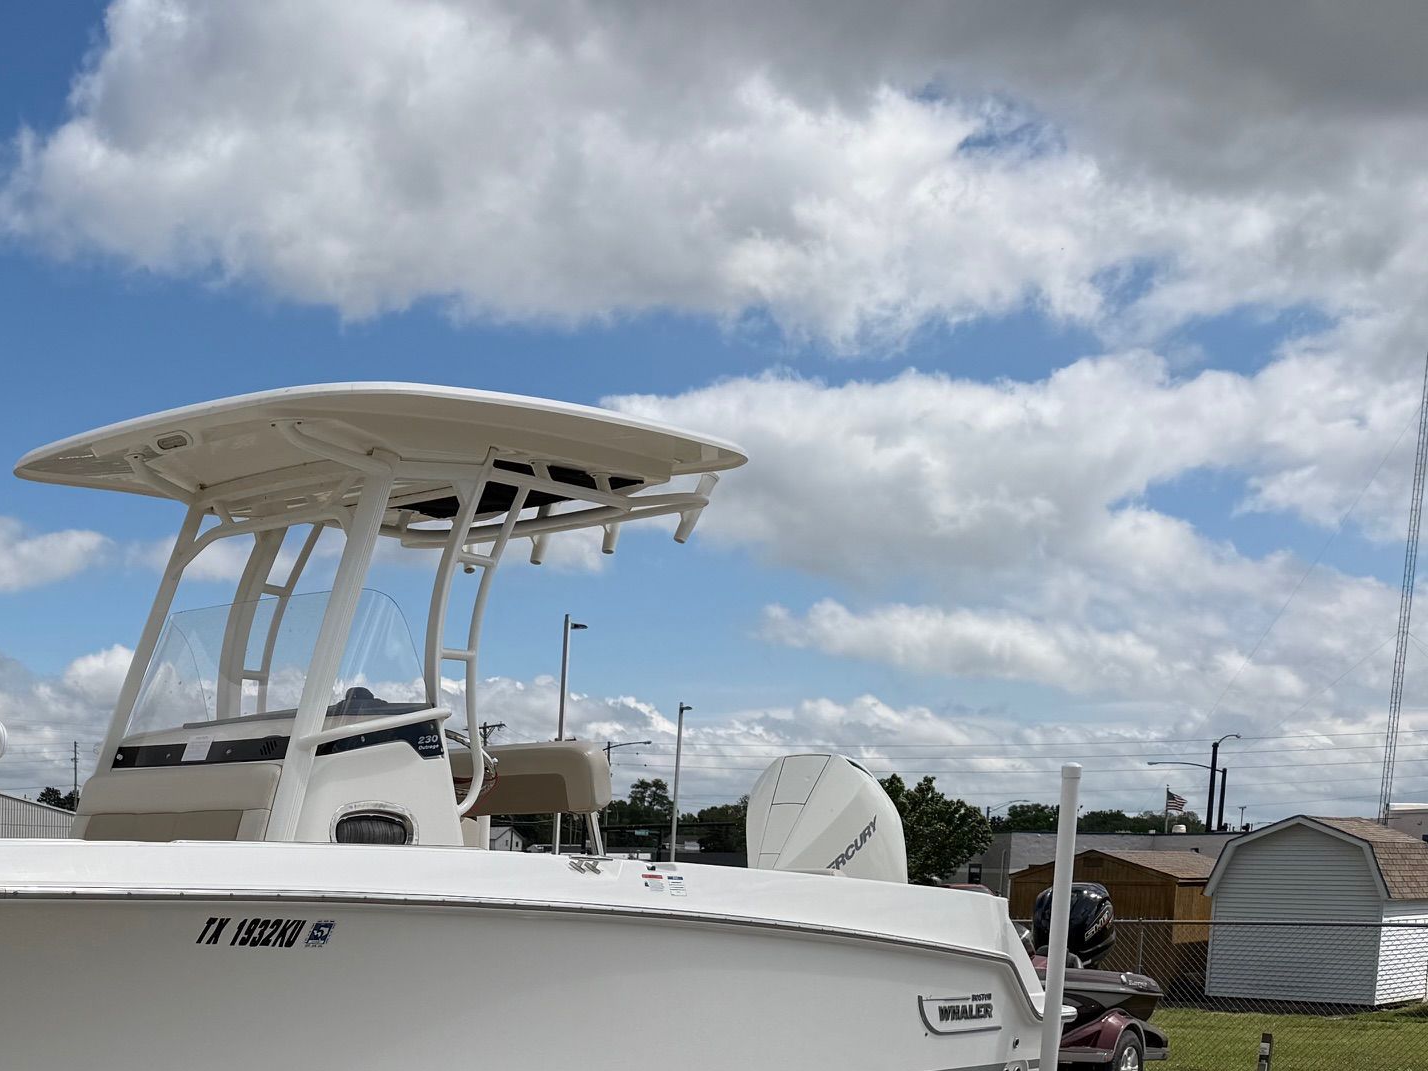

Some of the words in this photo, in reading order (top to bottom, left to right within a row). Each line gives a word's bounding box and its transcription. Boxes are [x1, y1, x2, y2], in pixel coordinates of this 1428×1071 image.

[417, 735, 439, 744] 230
[195, 917, 232, 945] TX
[229, 917, 307, 948] 1932KU
[938, 1003, 994, 1021] WHALER
